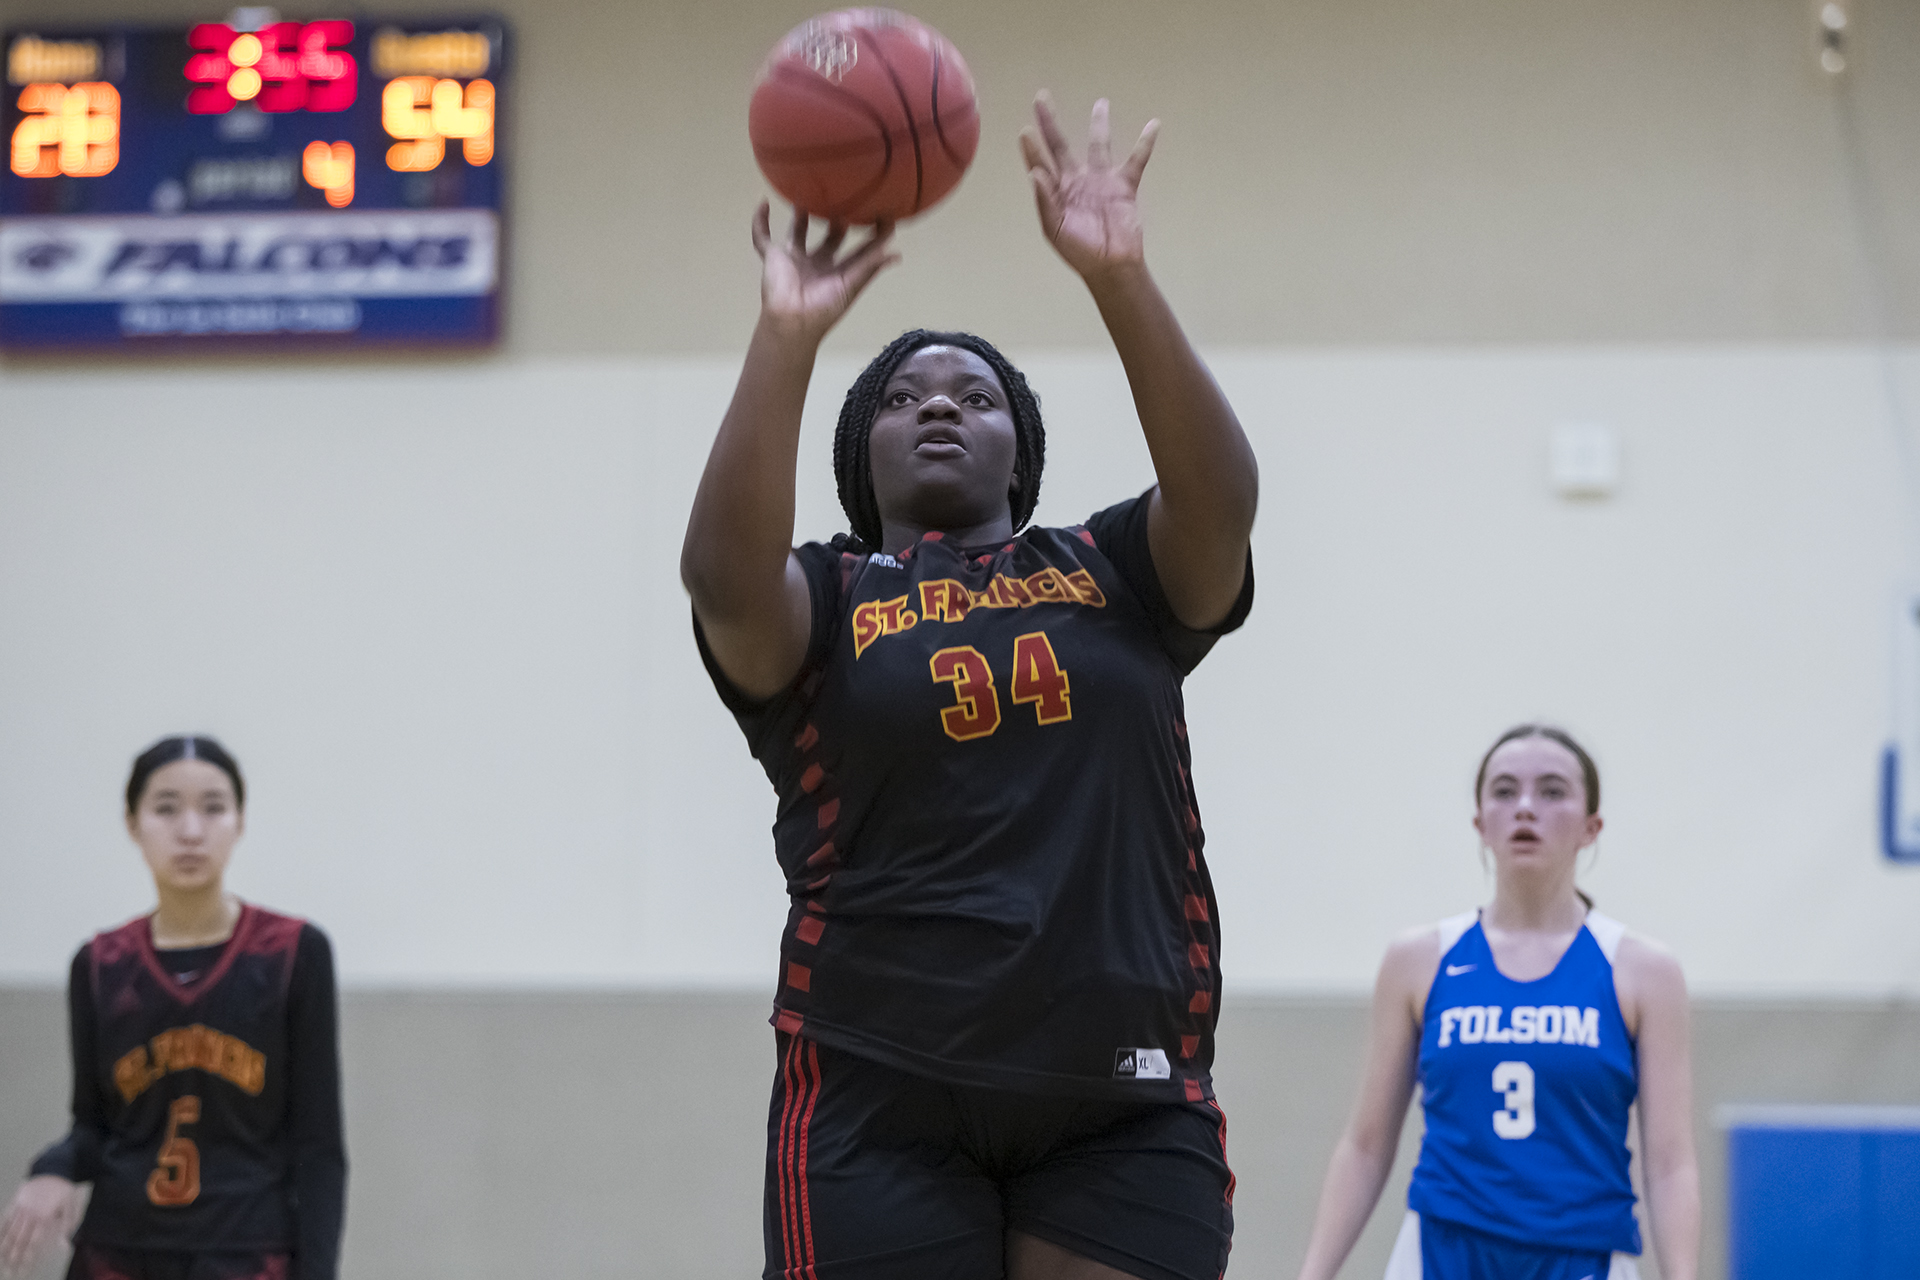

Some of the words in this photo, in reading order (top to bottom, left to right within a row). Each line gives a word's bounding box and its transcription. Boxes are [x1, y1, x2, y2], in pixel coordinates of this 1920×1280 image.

[382, 77, 495, 172] 54
[303, 141, 355, 208] 4
[852, 594, 918, 661] ST.
[929, 631, 1072, 742] 34
[1438, 1005, 1600, 1048] FOLSOM
[1492, 1061, 1536, 1140] 3
[147, 1095, 200, 1206] 5
